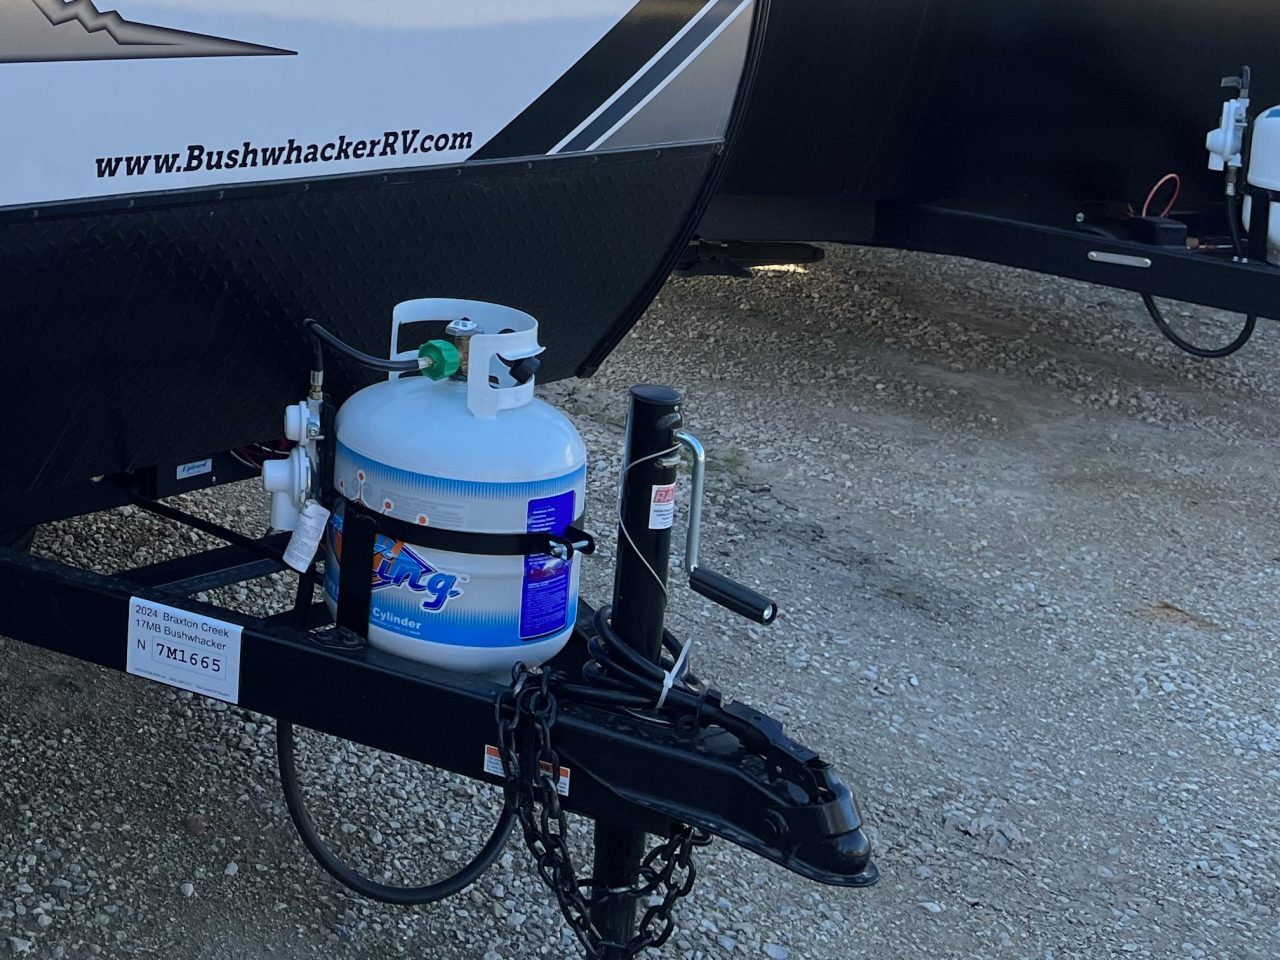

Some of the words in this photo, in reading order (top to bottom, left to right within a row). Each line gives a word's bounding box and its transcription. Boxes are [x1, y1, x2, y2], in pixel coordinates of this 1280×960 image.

[95, 129, 473, 178] www.BushwhackerRV.com
[135, 605, 158, 618] 2024
[163, 612, 198, 629] Braxton
[201, 623, 229, 638] Creek
[136, 619, 161, 633] 17MB
[164, 626, 226, 651] Bushwhacker
[372, 607, 422, 630] Cylinder
[137, 639, 146, 650] N
[156, 642, 221, 672] 7M1665
